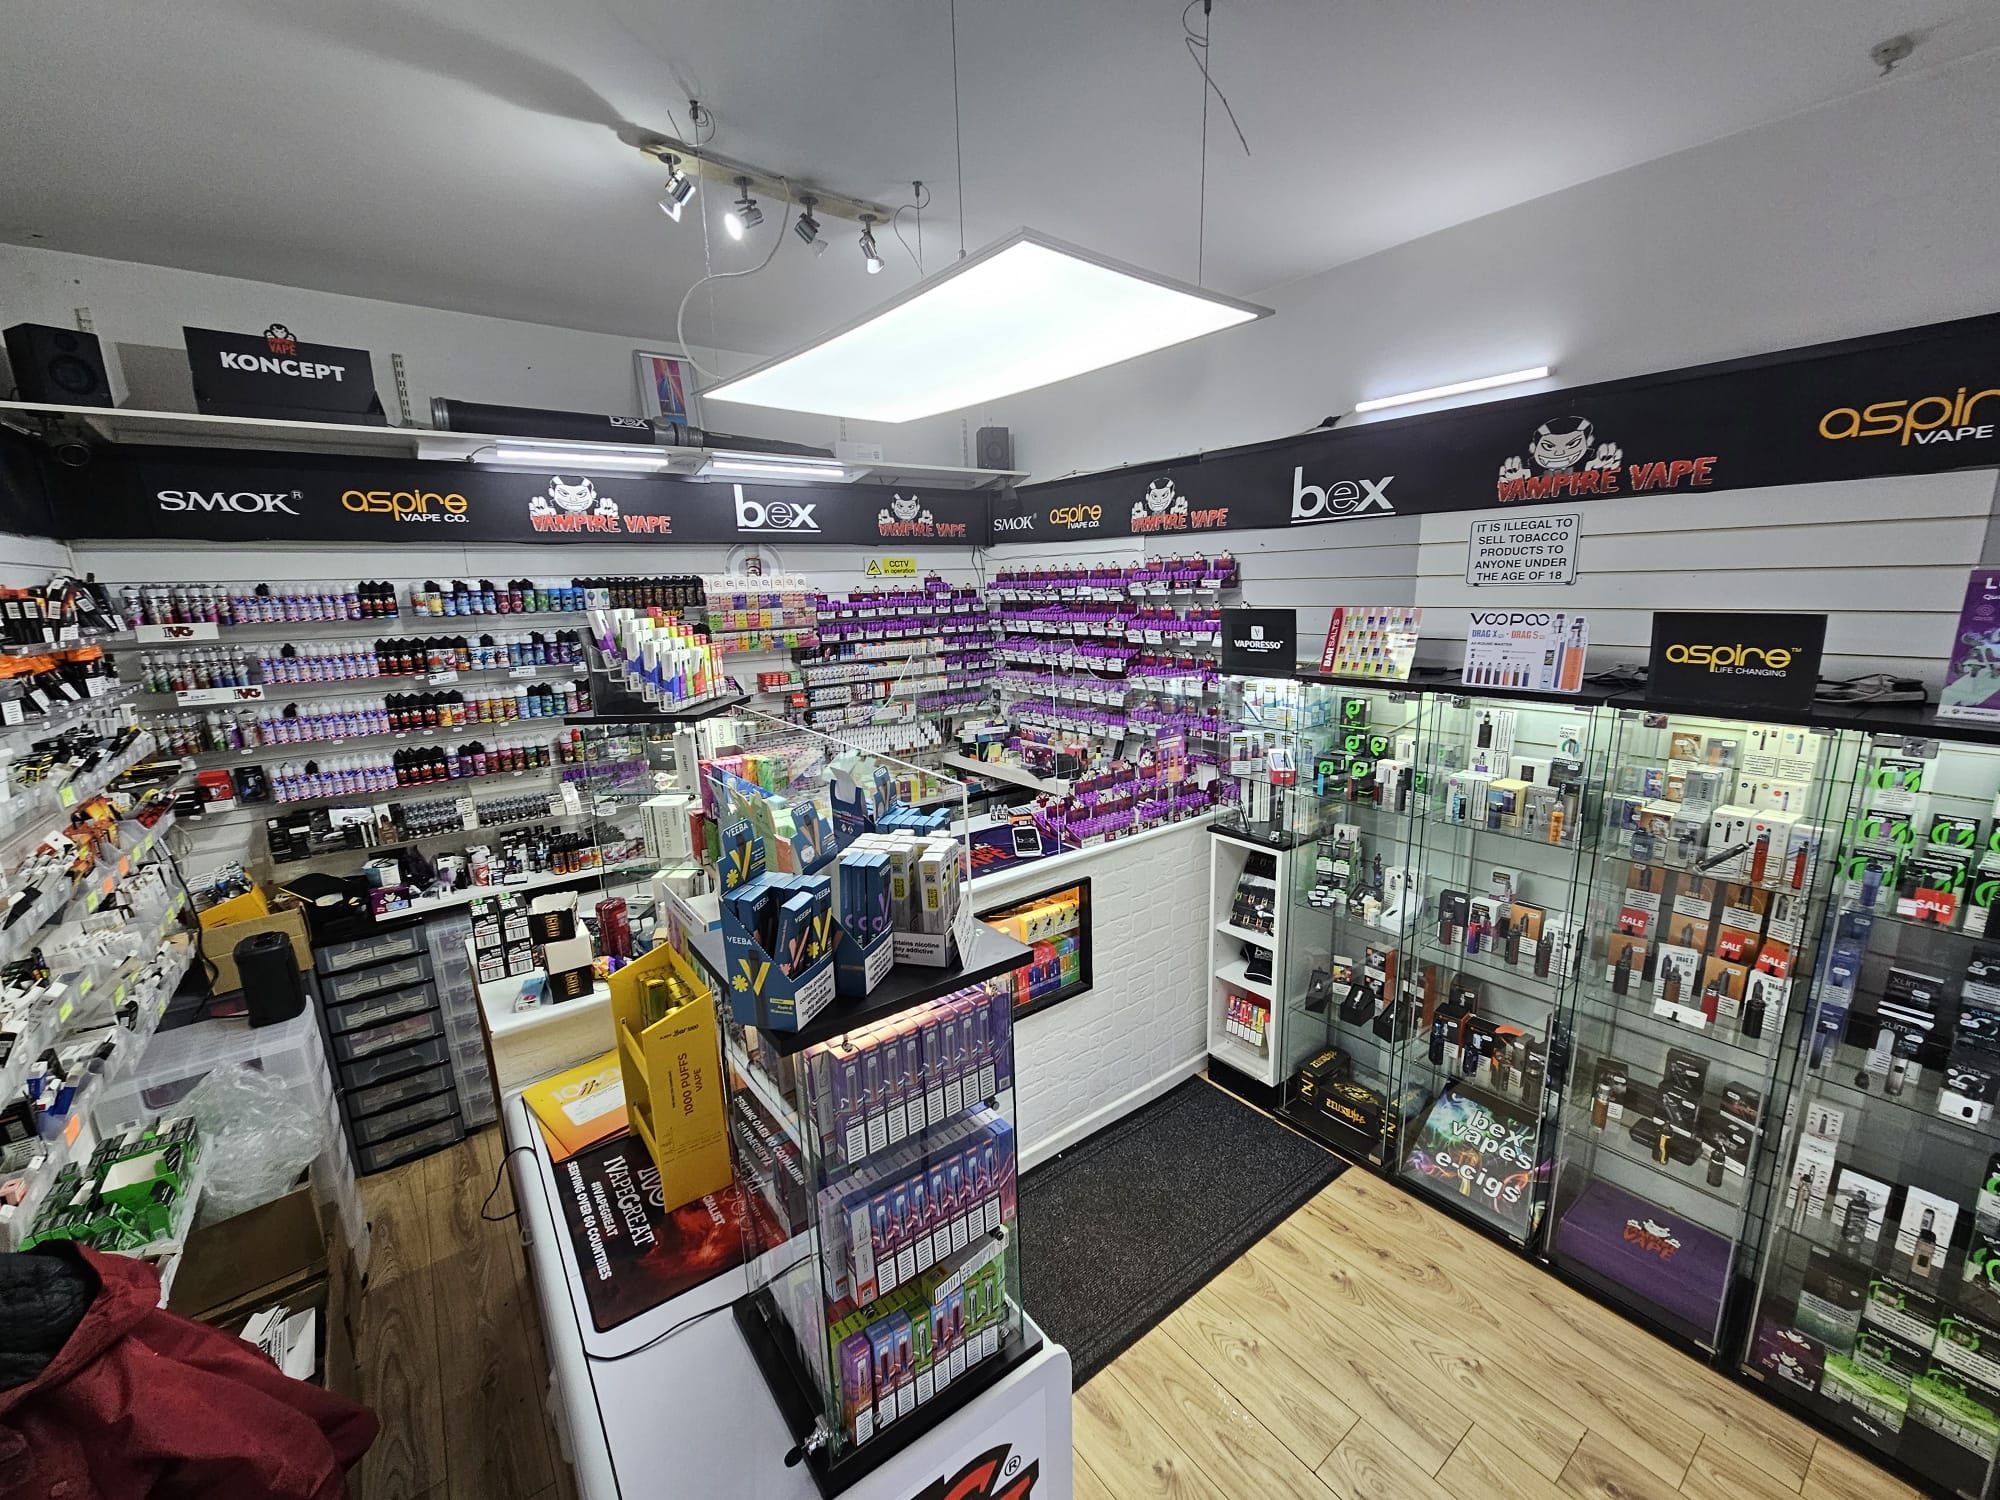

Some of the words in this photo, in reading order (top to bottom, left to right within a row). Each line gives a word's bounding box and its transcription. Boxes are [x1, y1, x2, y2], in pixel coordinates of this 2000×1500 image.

[269, 341, 296, 355] VAPE
[220, 351, 345, 381] KONCEPT
[1914, 424, 1995, 445] VAPE
[1497, 467, 1621, 502] VAMPIRE
[1629, 457, 1718, 491] VAPE
[1292, 467, 1395, 520] bex
[341, 489, 468, 521] aspire
[733, 484, 818, 529] bex
[400, 512, 441, 523] VAPE
[444, 513, 469, 523] CO.
[530, 514, 621, 532] VAMPIRE
[623, 514, 672, 534] VAPE
[1050, 504, 1102, 529] aspire
[1131, 513, 1187, 533] VAMPIRE
[1191, 508, 1229, 528] VAPE
[1477, 523, 1486, 533] IT
[1490, 523, 1500, 532] IS
[1504, 520, 1552, 531] ILLEGAL
[1556, 518, 1573, 528] TO
[879, 522, 934, 537] VAMPIRE
[936, 522, 966, 537] VAPE
[1478, 536, 1506, 545] SELL
[1509, 532, 1569, 543] TOBACCO
[1480, 546, 1544, 557] PRODUCTS
[1547, 545, 1564, 554] TO
[1475, 559, 1521, 569] ANYONE
[1525, 558, 1567, 568] UNDER
[1477, 572, 1498, 581] THE
[1501, 571, 1525, 580] AGE
[1528, 571, 1545, 580] OF
[1549, 571, 1562, 579] 18
[1470, 612, 1550, 626] VOOPOO
[1327, 618, 1340, 646] SALTS
[1472, 629, 1491, 638] DRAG
[1492, 630, 1498, 638] X
[1511, 630, 1532, 639] DRAG
[1233, 640, 1281, 649] VAPORESSO
[1323, 647, 1335, 667] BAR
[1665, 644, 1792, 673] aspire
[1735, 667, 1787, 677] CHANGING
[793, 802, 812, 817] VEEBA
[725, 822, 749, 838] VEEBA
[814, 887, 831, 901] VEEBA
[1915, 899, 1950, 915] SALE
[1620, 915, 1645, 928] SALE
[726, 935, 753, 946] VEEBA
[1720, 941, 1742, 953] SALE
[1760, 954, 1788, 970] SALE
[678, 1052, 692, 1089] PUFFS
[693, 1067, 703, 1093] VAPE
[682, 1090, 694, 1116] 1000
[1471, 1110, 1524, 1147] bex
[1452, 1120, 1533, 1170] vapes
[567, 1160, 586, 1194] SERVING
[1435, 1152, 1521, 1203] e-cigs
[576, 1192, 592, 1218] OVER
[591, 1181, 618, 1237] #IVAPEGREAT
[583, 1214, 596, 1228] 60
[587, 1225, 612, 1281] COUNTRIES
